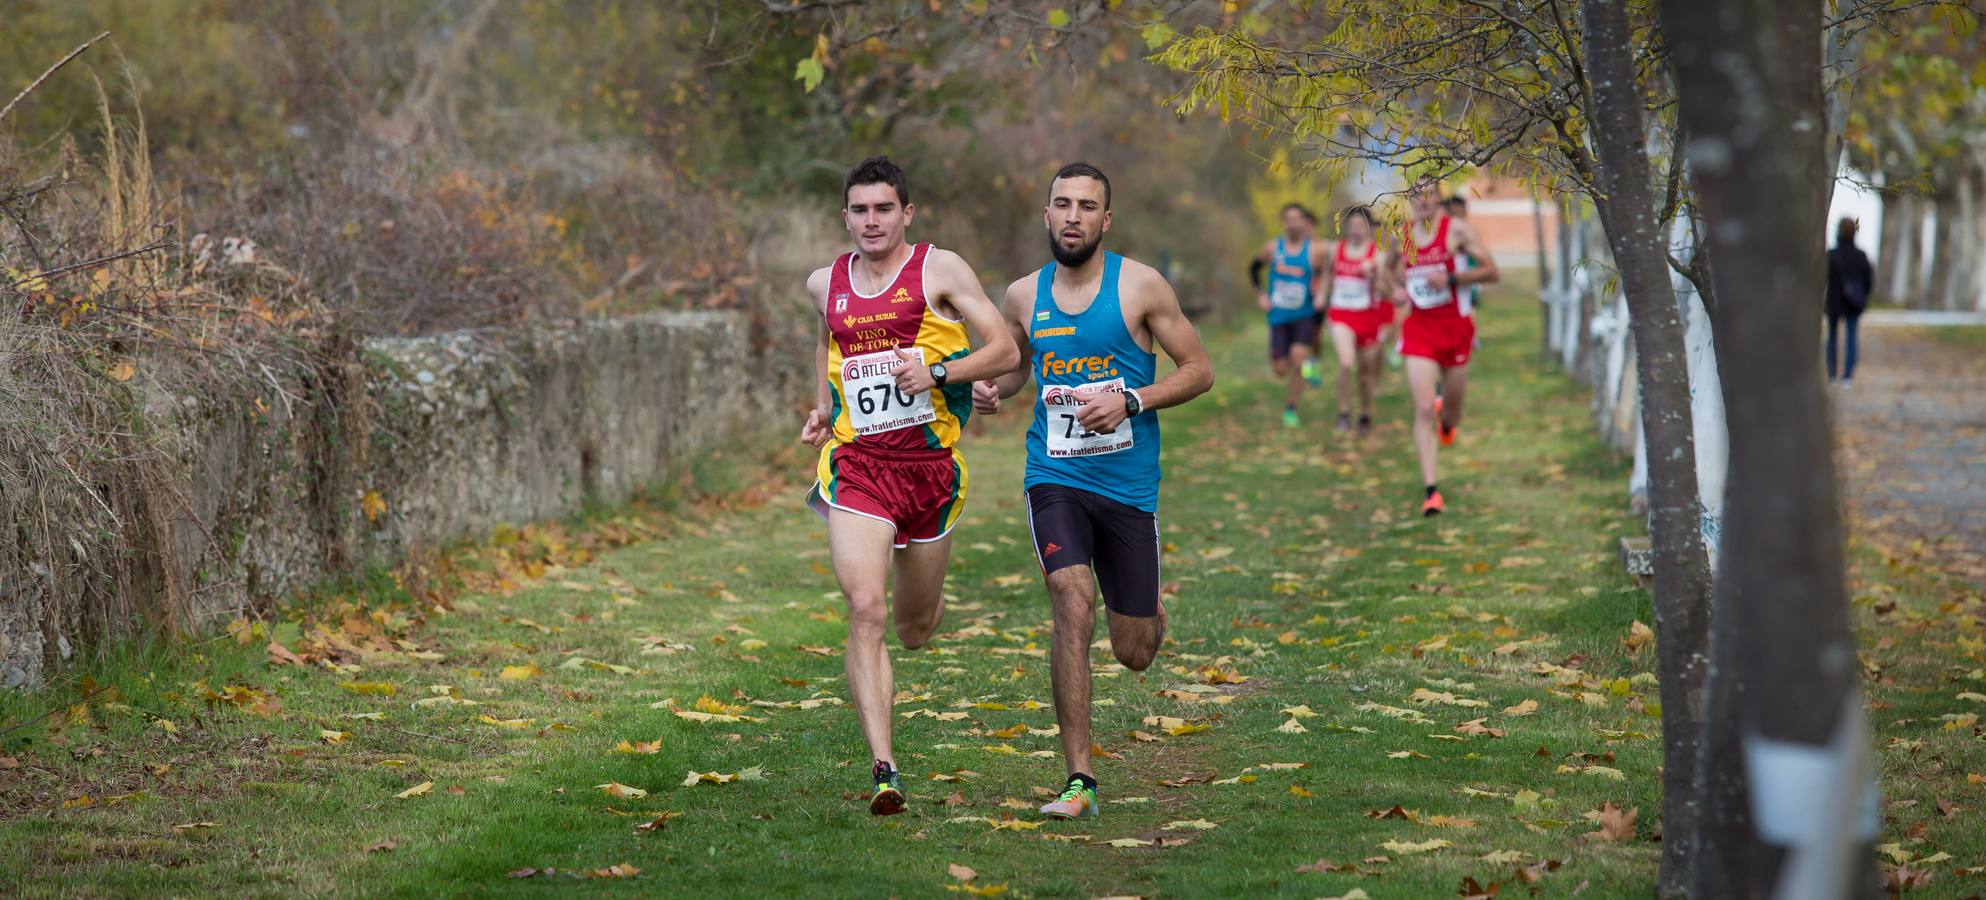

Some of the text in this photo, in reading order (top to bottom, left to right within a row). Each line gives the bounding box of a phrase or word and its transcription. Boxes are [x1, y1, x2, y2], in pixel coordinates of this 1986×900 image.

[857, 312, 898, 324] CAJA RURAL
[856, 328, 886, 340] VINO
[849, 338, 899, 354] DE TORO
[1087, 371, 1109, 381] sport
[857, 383, 915, 415] 670
[1049, 440, 1132, 456] www.fratletismo.com
